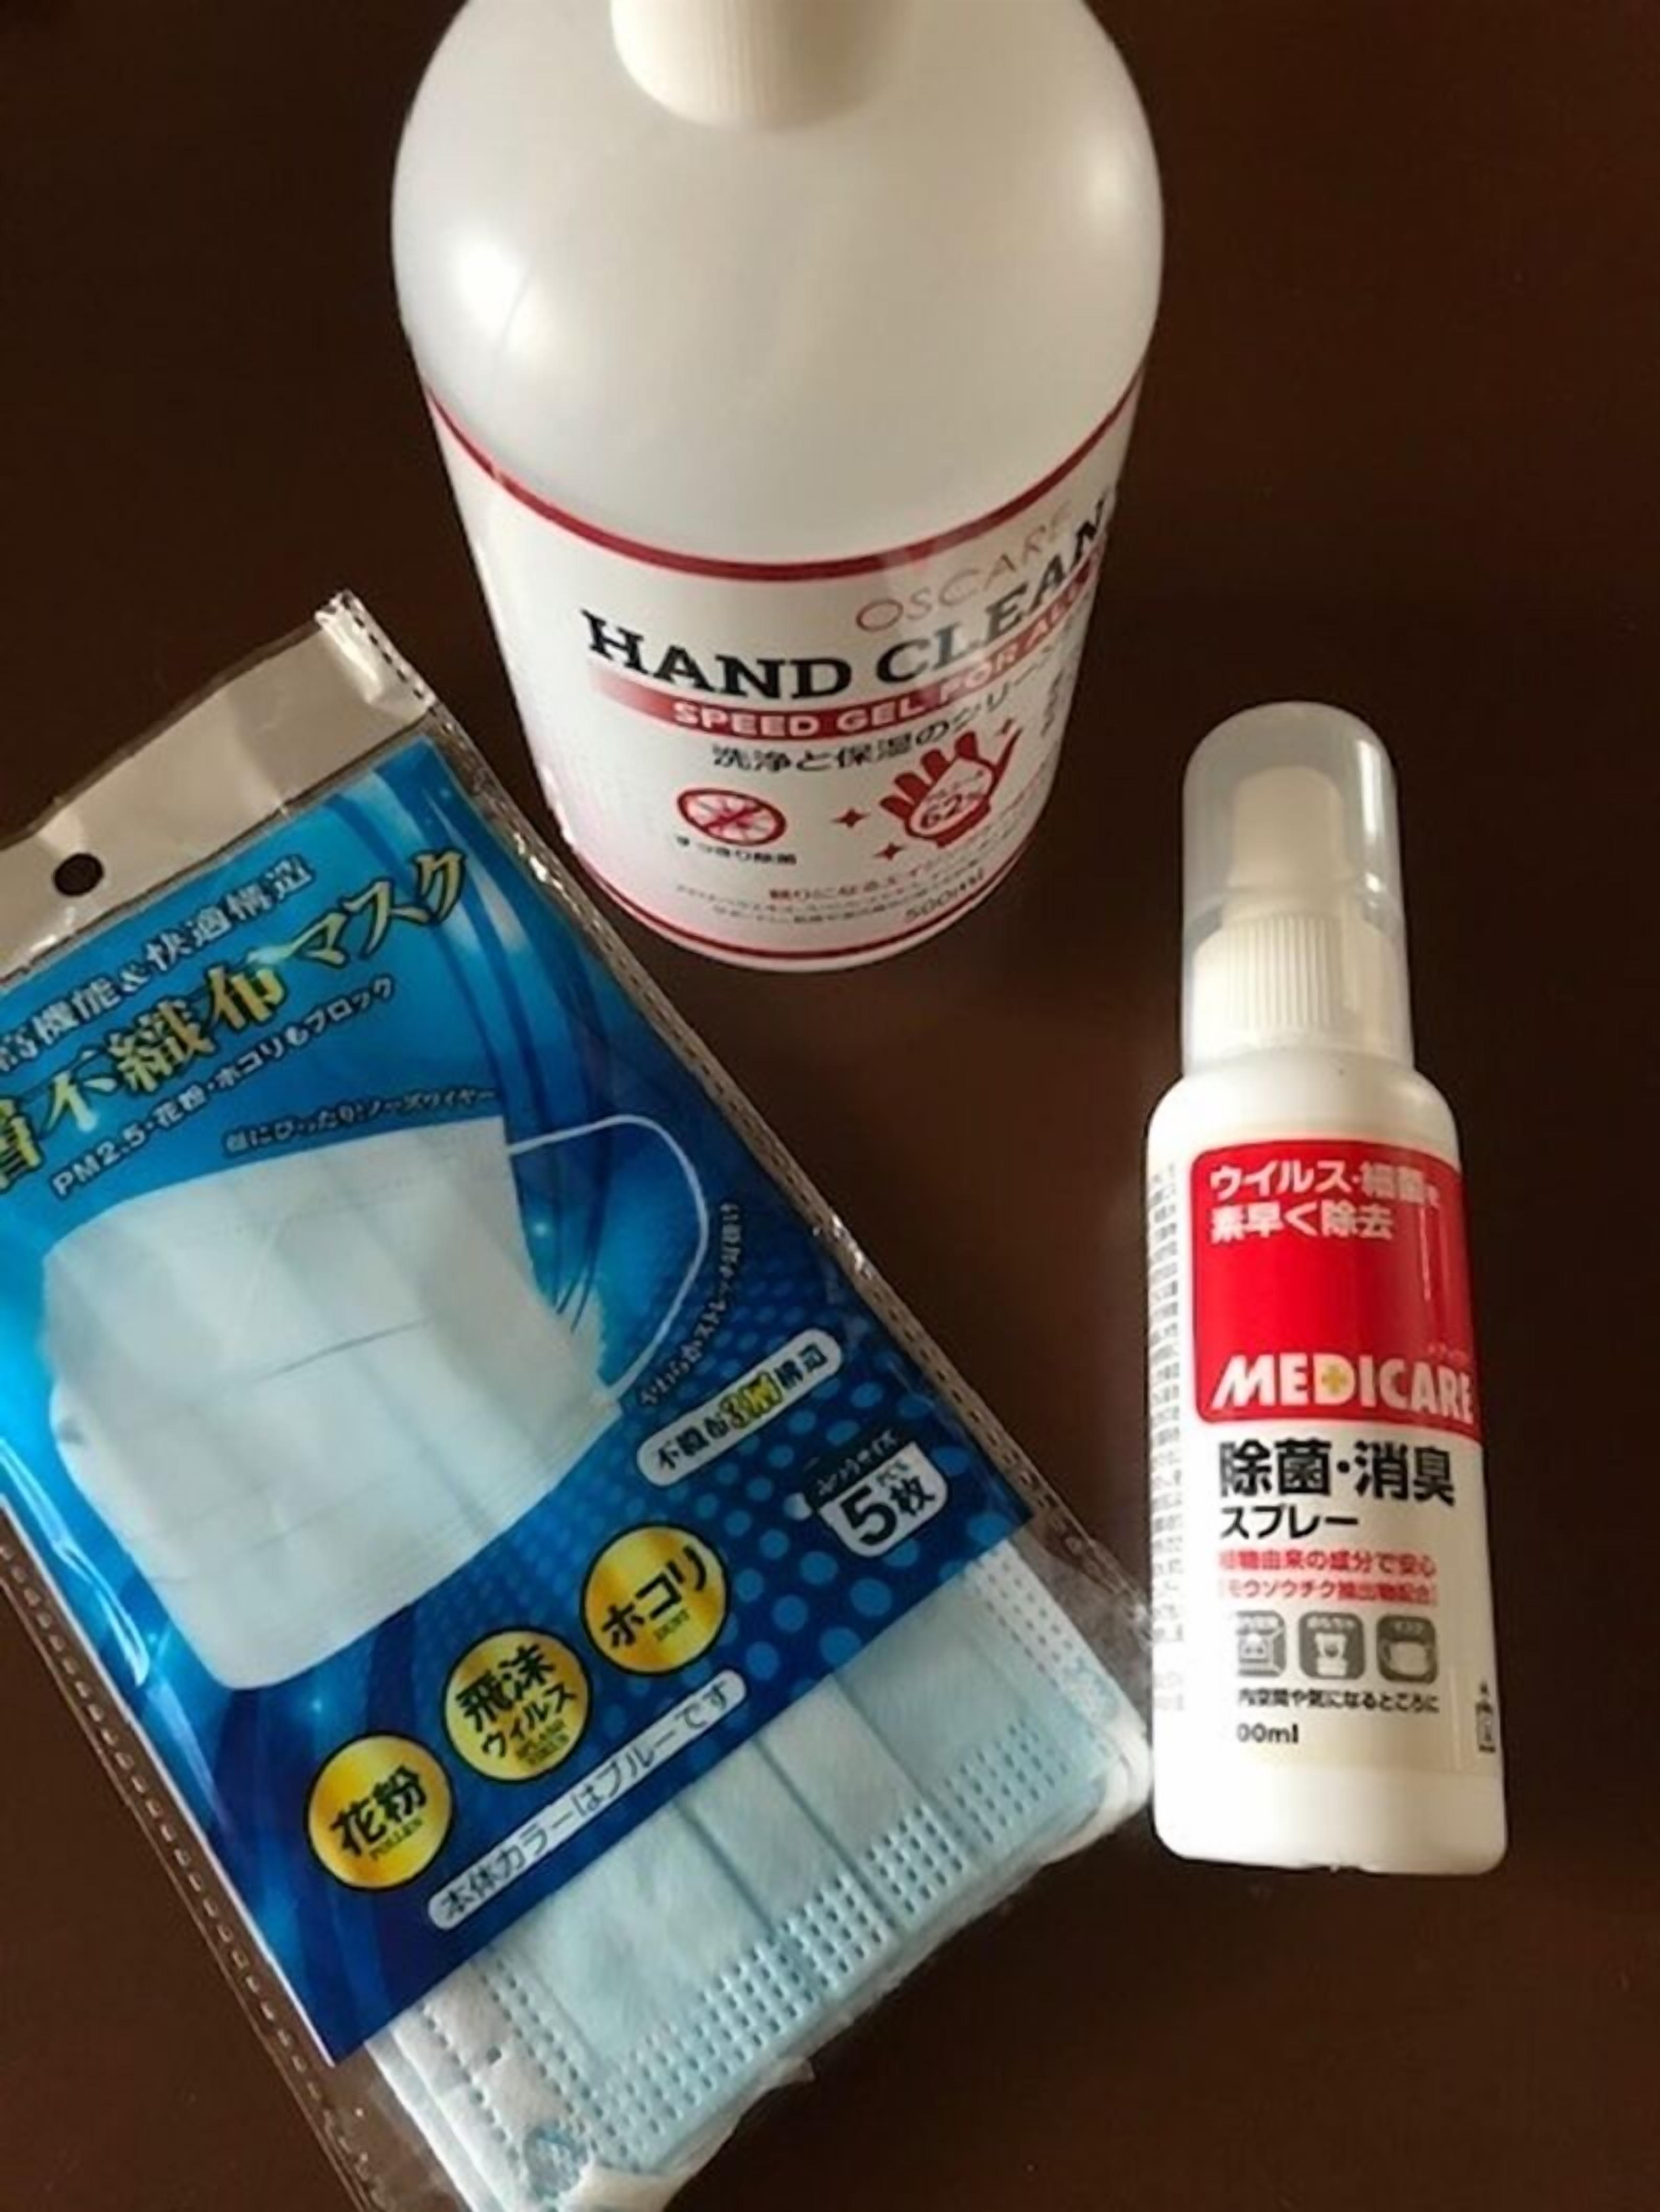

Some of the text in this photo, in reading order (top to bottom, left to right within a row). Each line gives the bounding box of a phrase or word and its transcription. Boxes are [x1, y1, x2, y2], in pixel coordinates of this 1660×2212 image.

[581, 608, 852, 700] HAND
[674, 700, 821, 738] SPEED
[838, 695, 926, 733] GEL
[1211, 1352, 1474, 1424] MEDICARE
[1218, 1439, 1455, 1506] 除菌・消臭
[839, 1475, 936, 1546] 5枚
[1220, 1505, 1359, 1540] スプレー
[602, 1546, 708, 1649] ホコリ
[455, 1643, 556, 1733] 飛沫
[331, 1765, 428, 1856] 花粉
